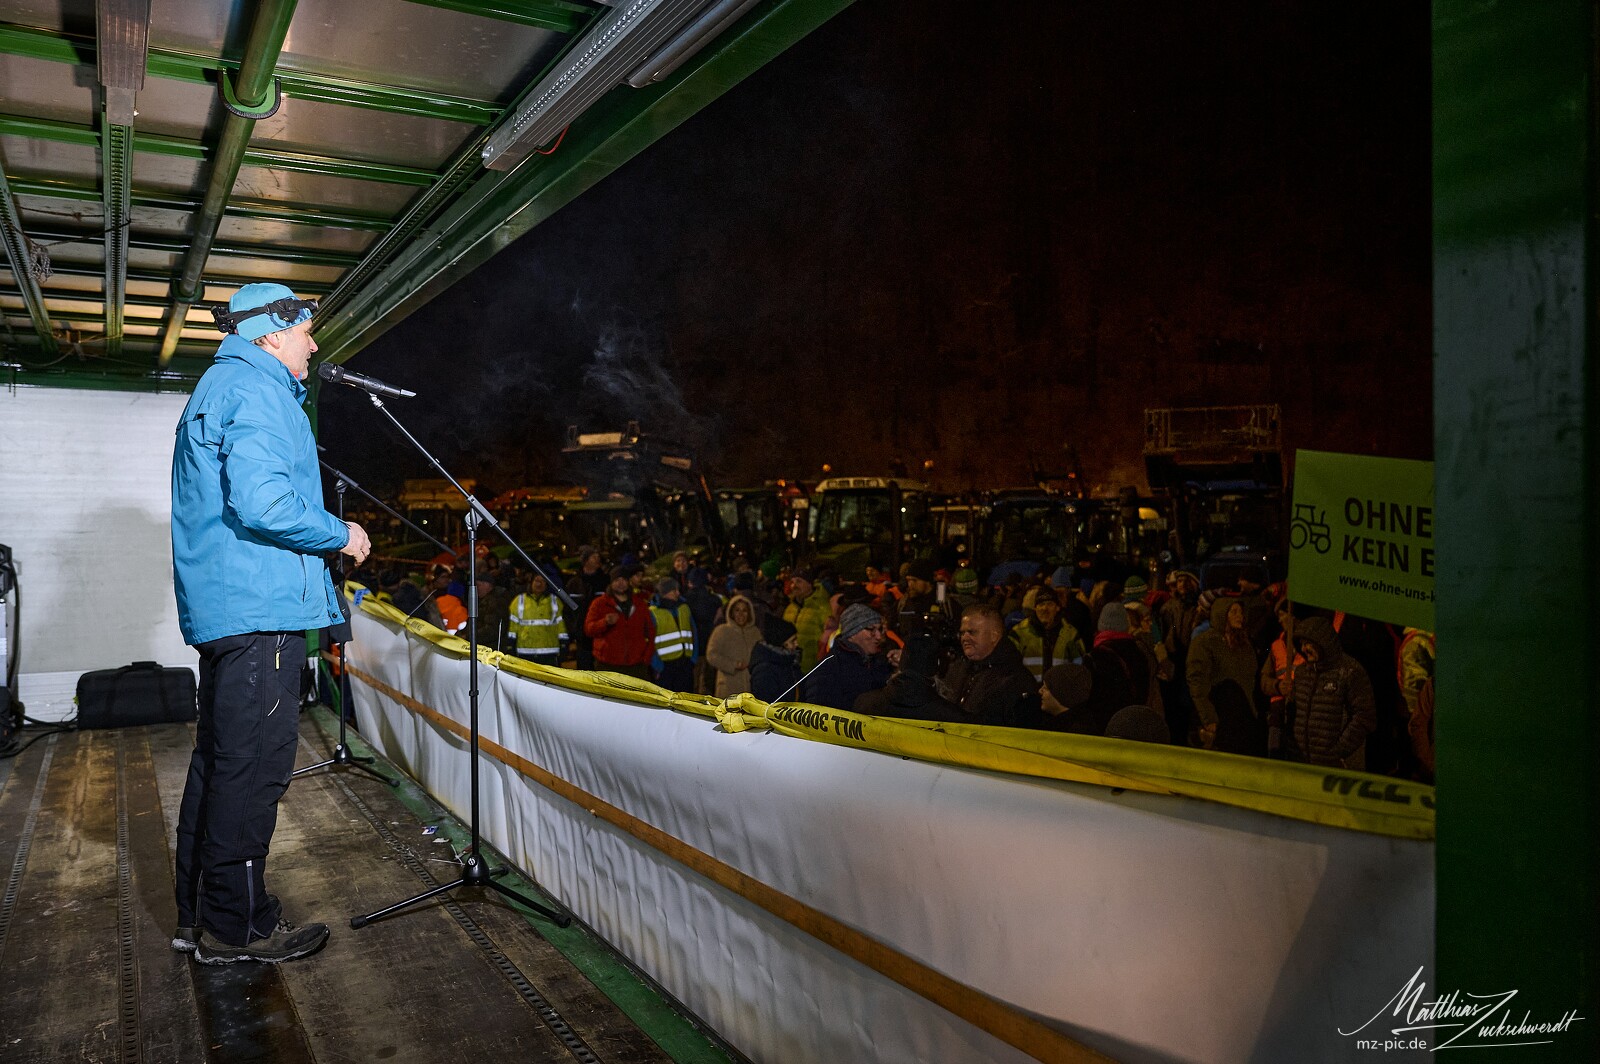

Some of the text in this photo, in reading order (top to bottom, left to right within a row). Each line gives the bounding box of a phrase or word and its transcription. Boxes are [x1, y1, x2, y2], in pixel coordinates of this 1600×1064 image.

[1344, 497, 1432, 538] OHNE
[1342, 534, 1409, 573] KEIN
[831, 715, 866, 742] WLL
